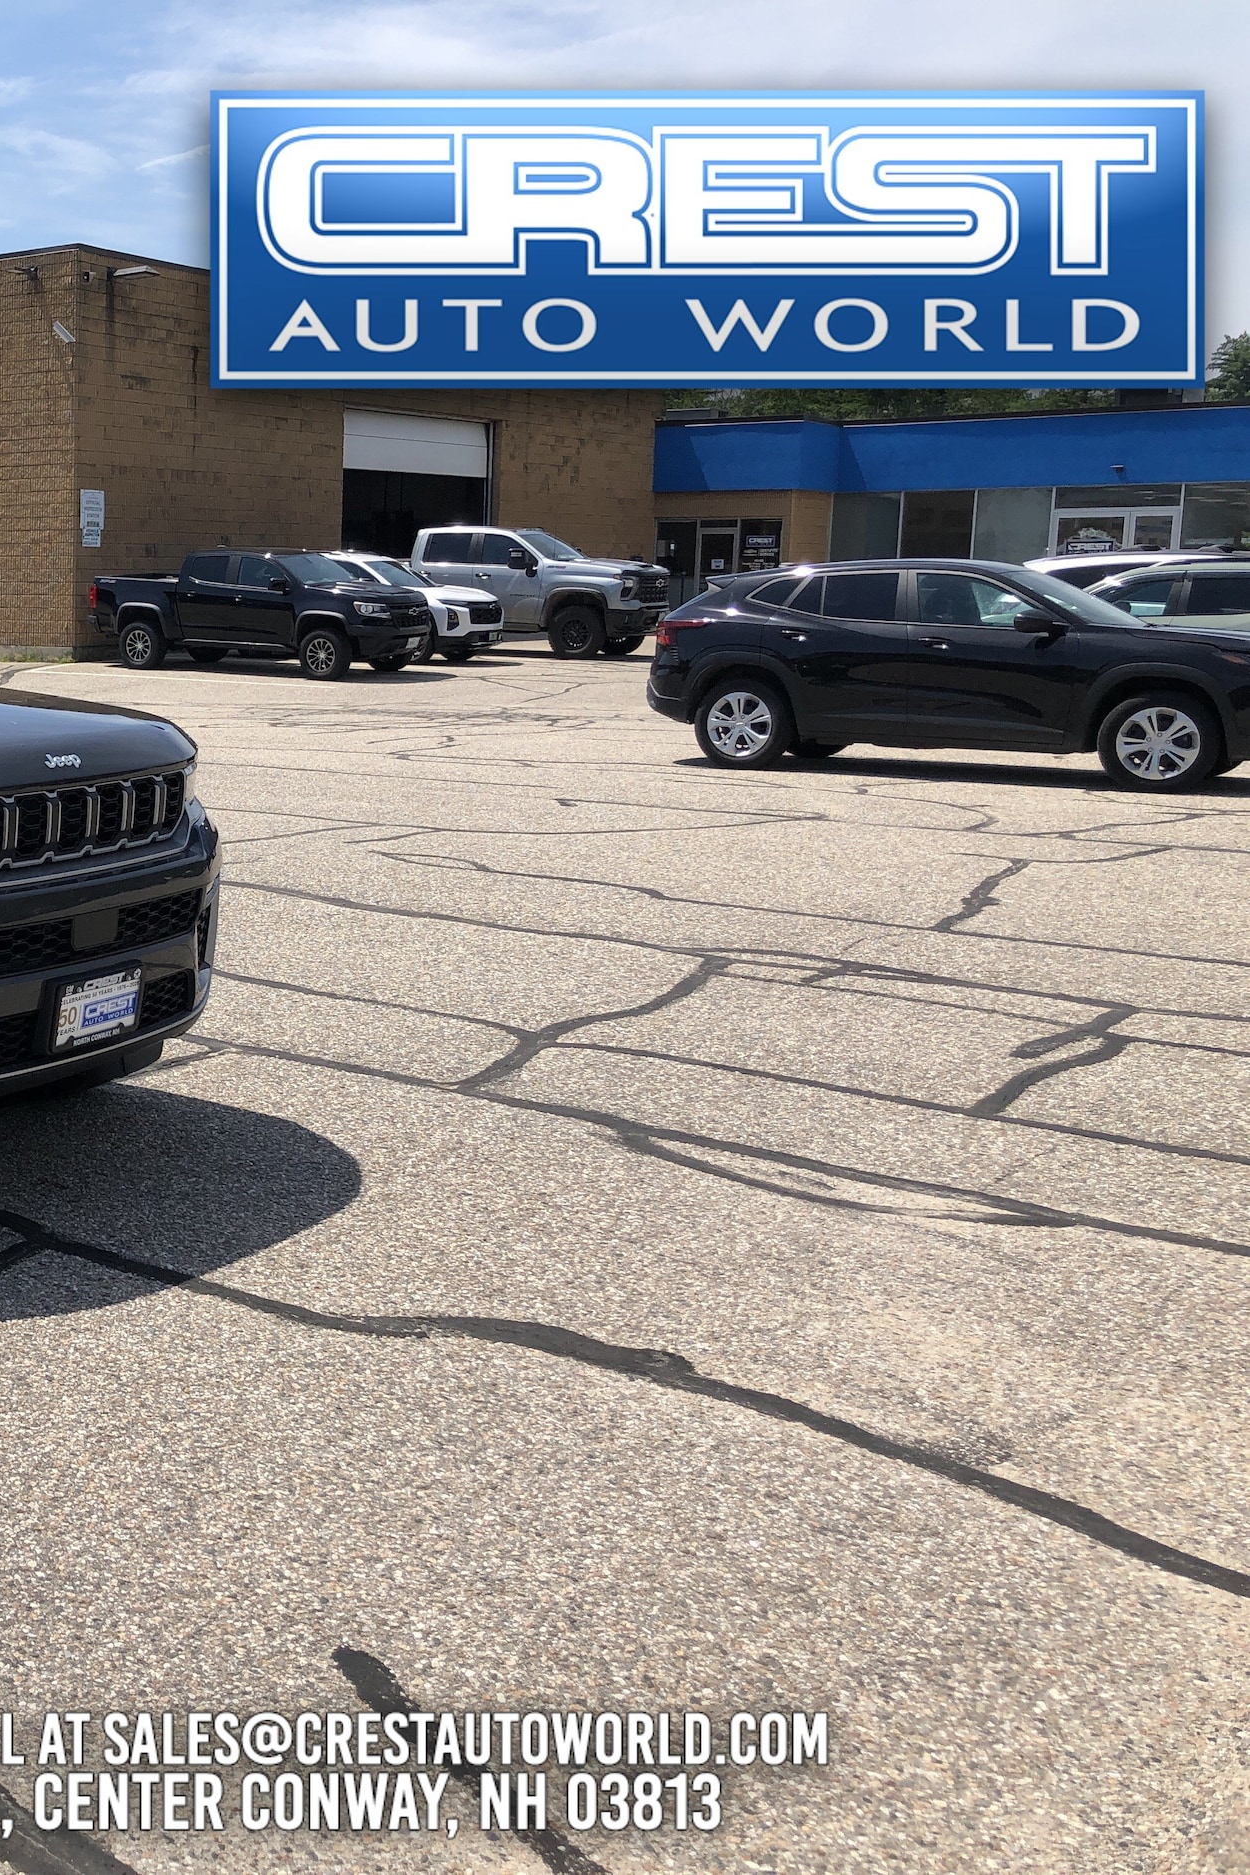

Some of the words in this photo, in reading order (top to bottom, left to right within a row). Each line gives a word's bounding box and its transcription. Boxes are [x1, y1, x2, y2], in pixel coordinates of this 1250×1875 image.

[44, 753, 82, 769] Jeep
[83, 972, 126, 991] CREST
[85, 994, 136, 1019] CREST
[58, 1006, 77, 1028] 50
[84, 1015, 104, 1026] AUTO
[107, 1007, 134, 1019] WORLD
[73, 1036, 90, 1047] NORTH
